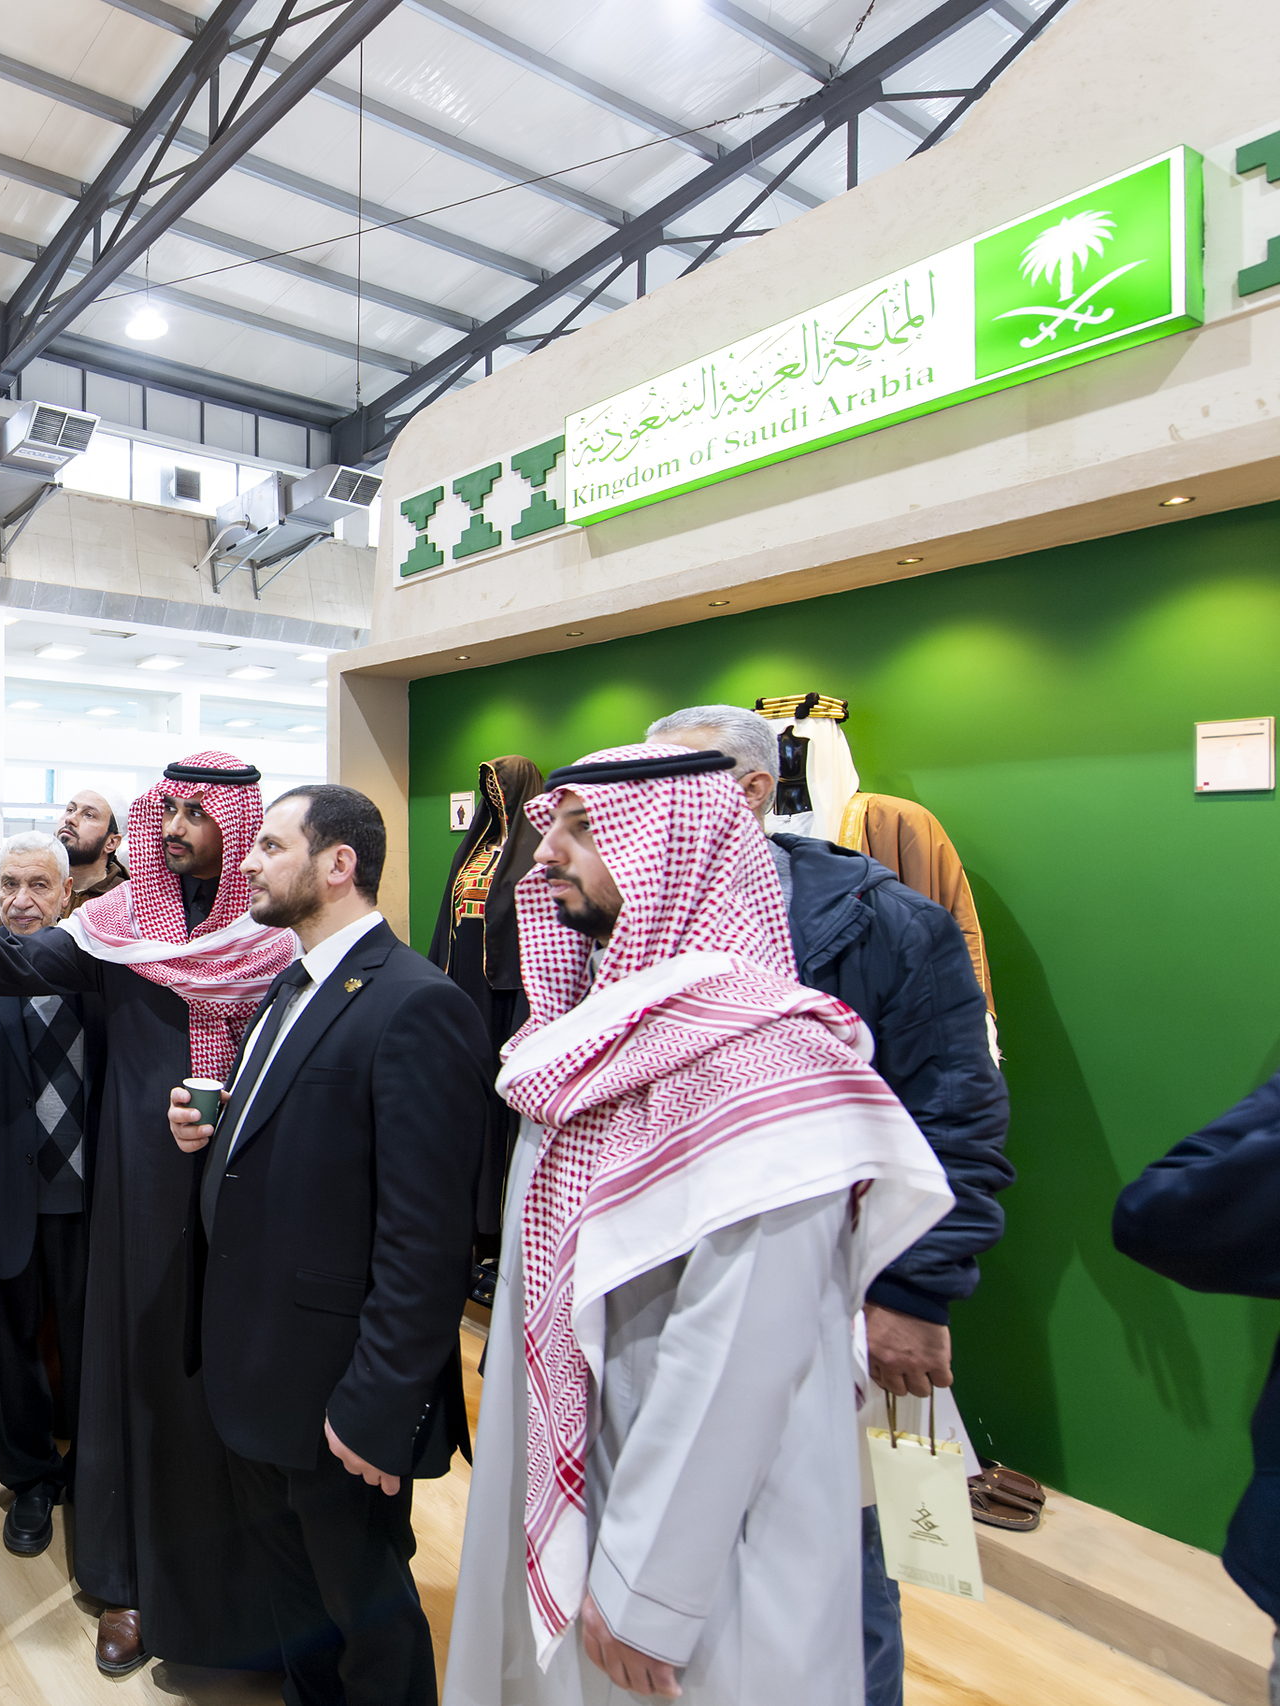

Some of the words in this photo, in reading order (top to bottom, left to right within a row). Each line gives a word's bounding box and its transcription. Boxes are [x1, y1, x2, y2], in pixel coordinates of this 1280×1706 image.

[709, 319, 821, 420] العربية
[812, 269, 935, 386] المملكة
[572, 363, 719, 467] السعودية
[573, 457, 681, 508] Kingdom
[689, 437, 718, 466] of
[724, 405, 808, 455] Saudi
[819, 366, 934, 422] Arabia
